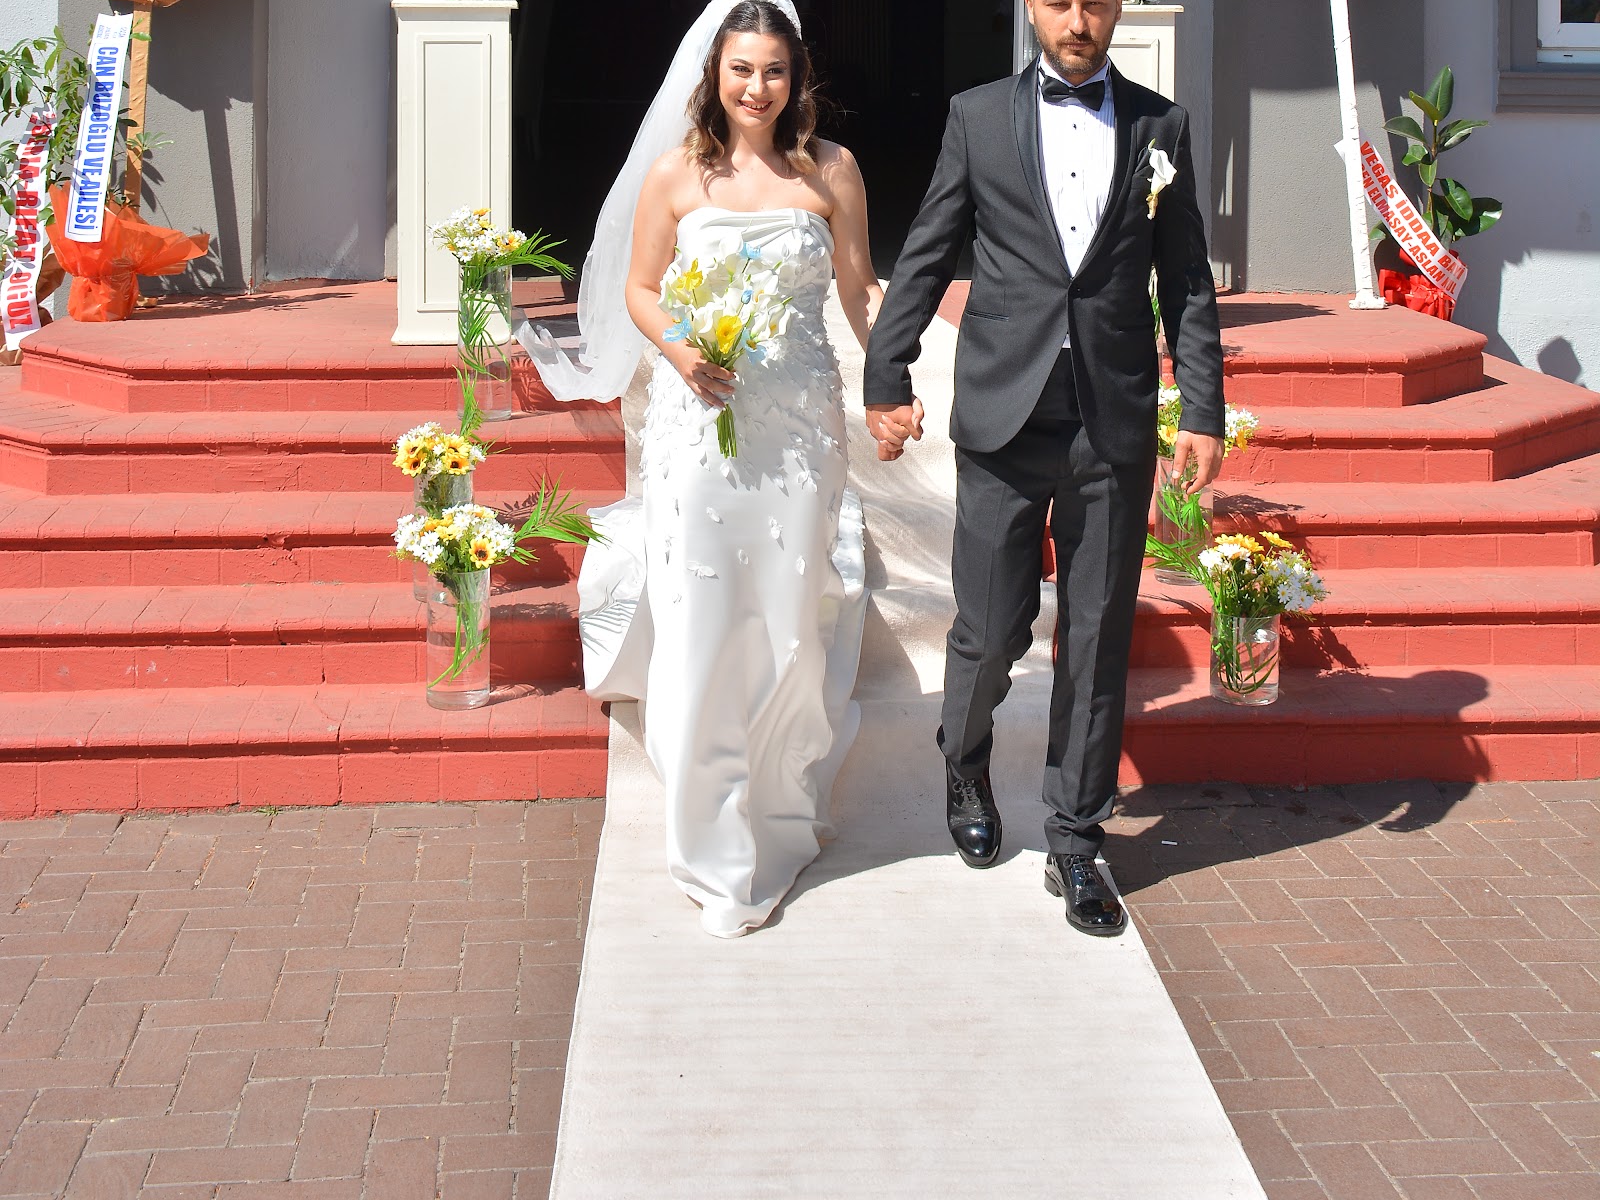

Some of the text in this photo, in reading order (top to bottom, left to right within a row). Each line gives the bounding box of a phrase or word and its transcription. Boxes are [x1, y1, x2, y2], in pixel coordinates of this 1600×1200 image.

[95, 47, 119, 76] CAN
[86, 81, 115, 153] BUZOĞLU
[81, 156, 105, 178] VE
[74, 178, 104, 231] AİLESİ
[1360, 141, 1465, 279] VEGAS İDDAA BAYİ
